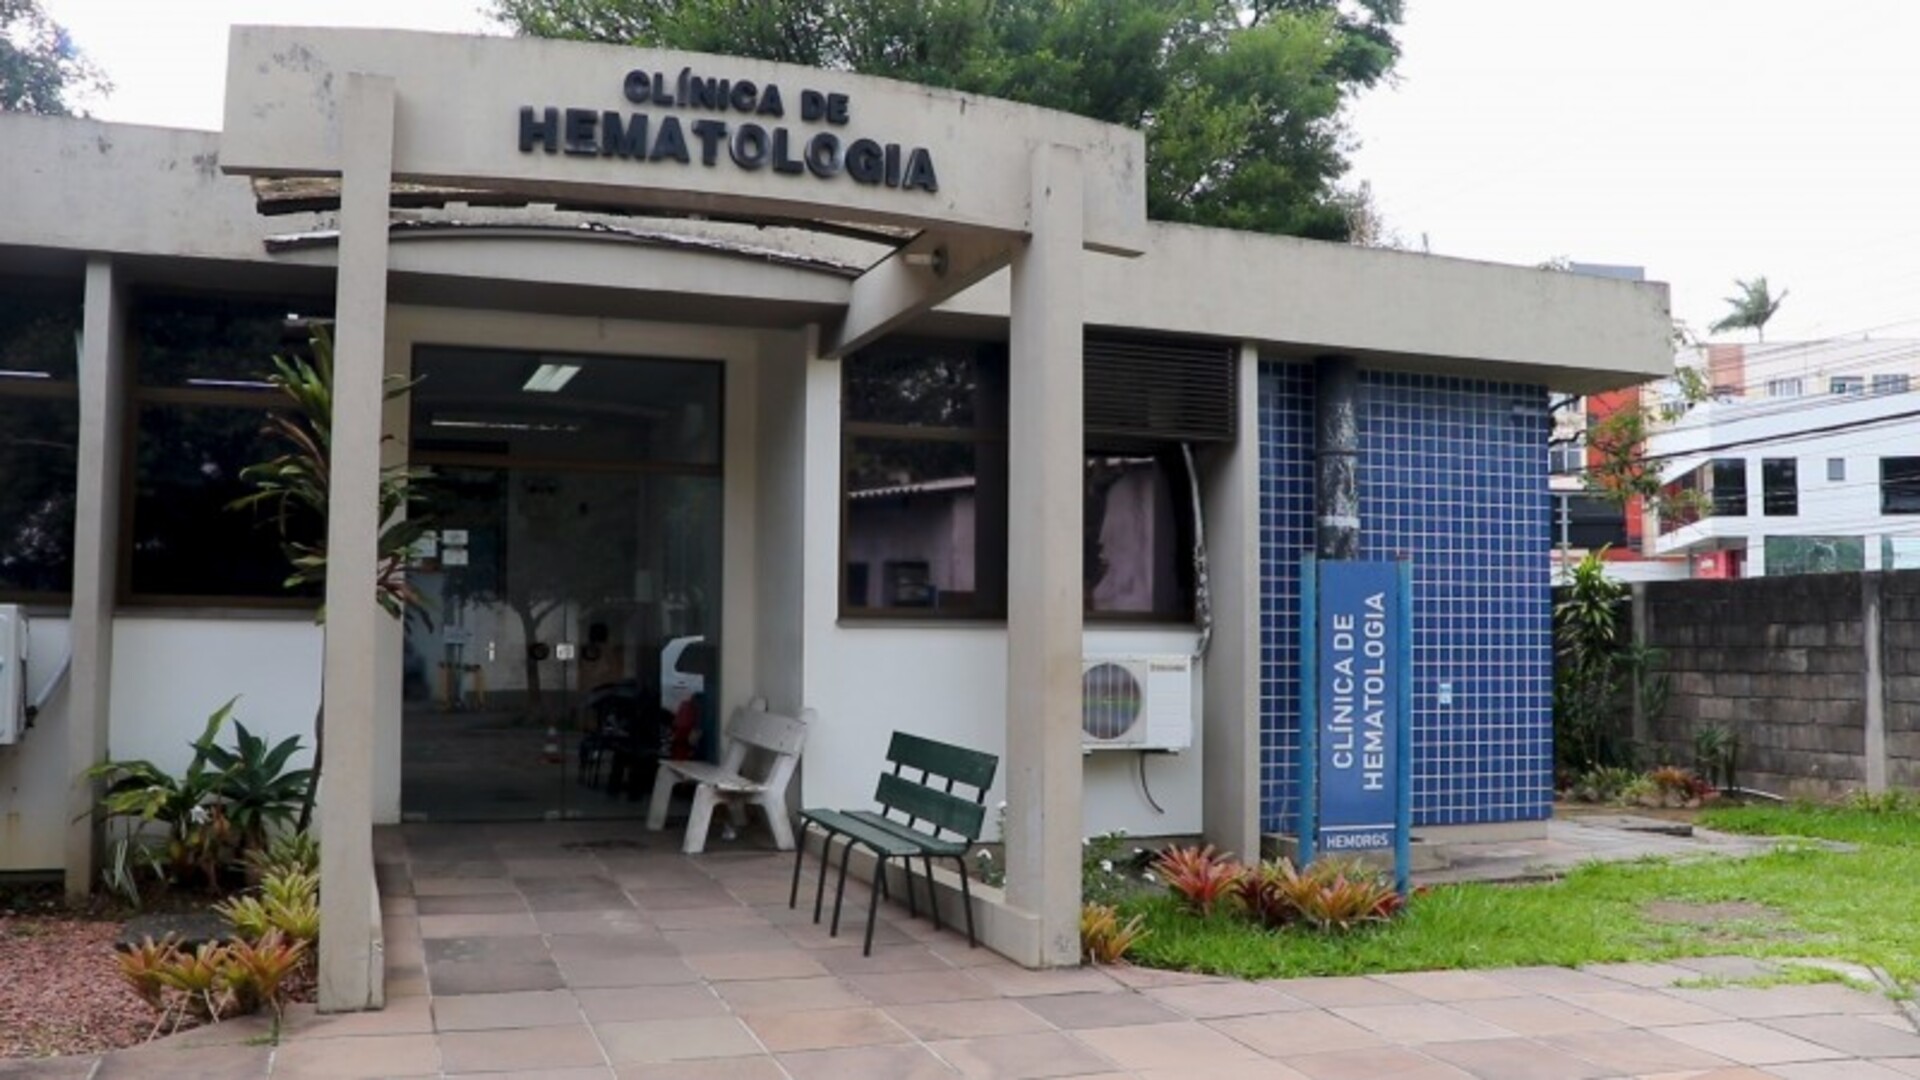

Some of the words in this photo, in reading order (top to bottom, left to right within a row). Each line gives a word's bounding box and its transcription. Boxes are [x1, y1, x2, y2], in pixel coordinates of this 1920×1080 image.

[623, 66, 784, 117] CLÍNICA
[800, 88, 850, 125] DE
[518, 105, 939, 193] HEMATOLOGIA
[1333, 613, 1354, 651] DE
[1327, 657, 1354, 769] CLÍNICA
[1363, 592, 1385, 790] HEMATOLOGIA
[1326, 833, 1388, 849] HEMORGS
